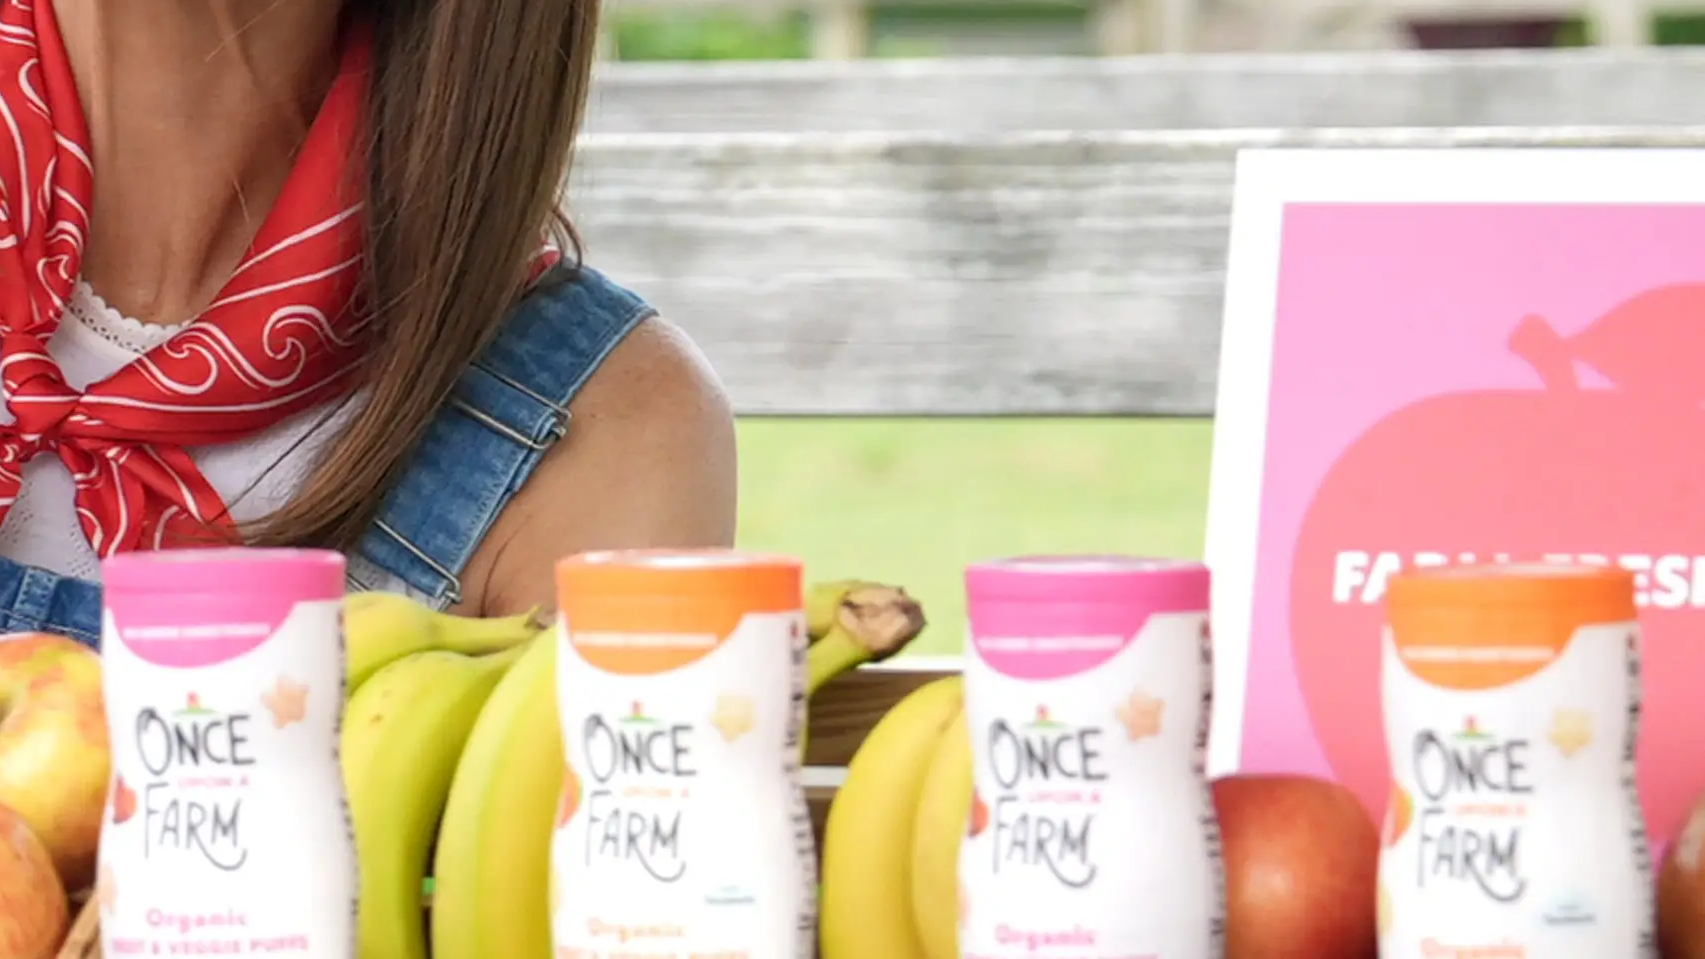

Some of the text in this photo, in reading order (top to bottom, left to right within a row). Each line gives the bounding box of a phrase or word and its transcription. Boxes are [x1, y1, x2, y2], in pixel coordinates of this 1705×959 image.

[135, 707, 256, 776] ONCE
[583, 713, 697, 782] ONCE
[989, 718, 1109, 789] ONCE
[1413, 728, 1534, 801] ONCE
[143, 781, 247, 871] FARM
[585, 790, 686, 883] FARM
[993, 795, 1097, 888] FARM
[1418, 806, 1527, 902] FARM
[145, 905, 248, 934] Organic
